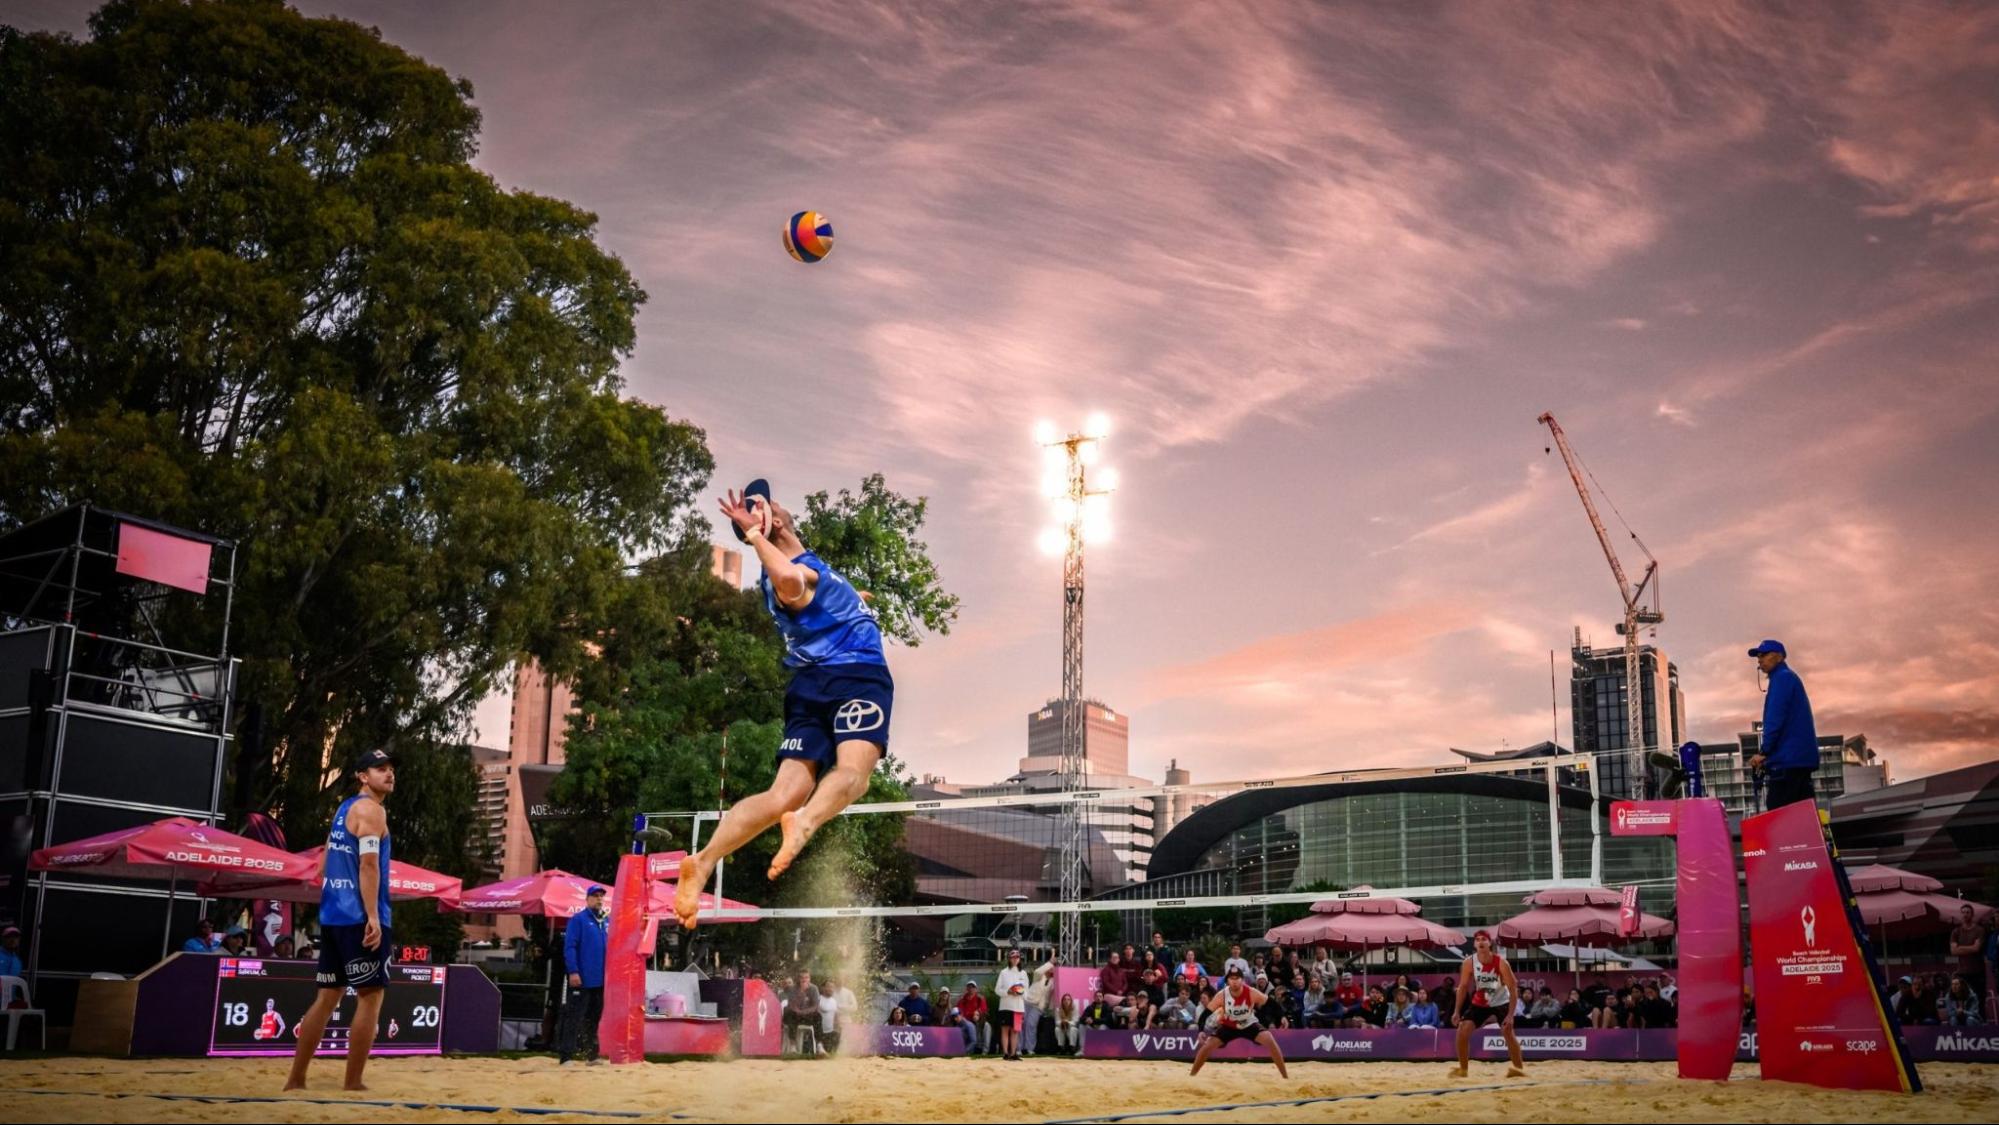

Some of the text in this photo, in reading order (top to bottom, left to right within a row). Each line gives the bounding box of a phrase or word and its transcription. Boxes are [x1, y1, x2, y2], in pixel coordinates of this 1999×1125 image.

[165, 851, 284, 871] ADELAIDE 2025
[1784, 860, 1818, 872] MiKASA
[402, 879, 436, 892] 2025
[1797, 954, 1847, 963] Championships
[1784, 964, 1841, 973] ADELAIDE 2025
[223, 1002, 249, 1026] 18
[412, 1005, 440, 1028] 20
[892, 1030, 923, 1053] scape
[1153, 1037, 1199, 1050] VBTV
[1335, 1040, 1373, 1049] ADELAIDE
[1488, 1039, 1583, 1048] ADAIDE 2025
[1846, 1040, 1877, 1056] scape
